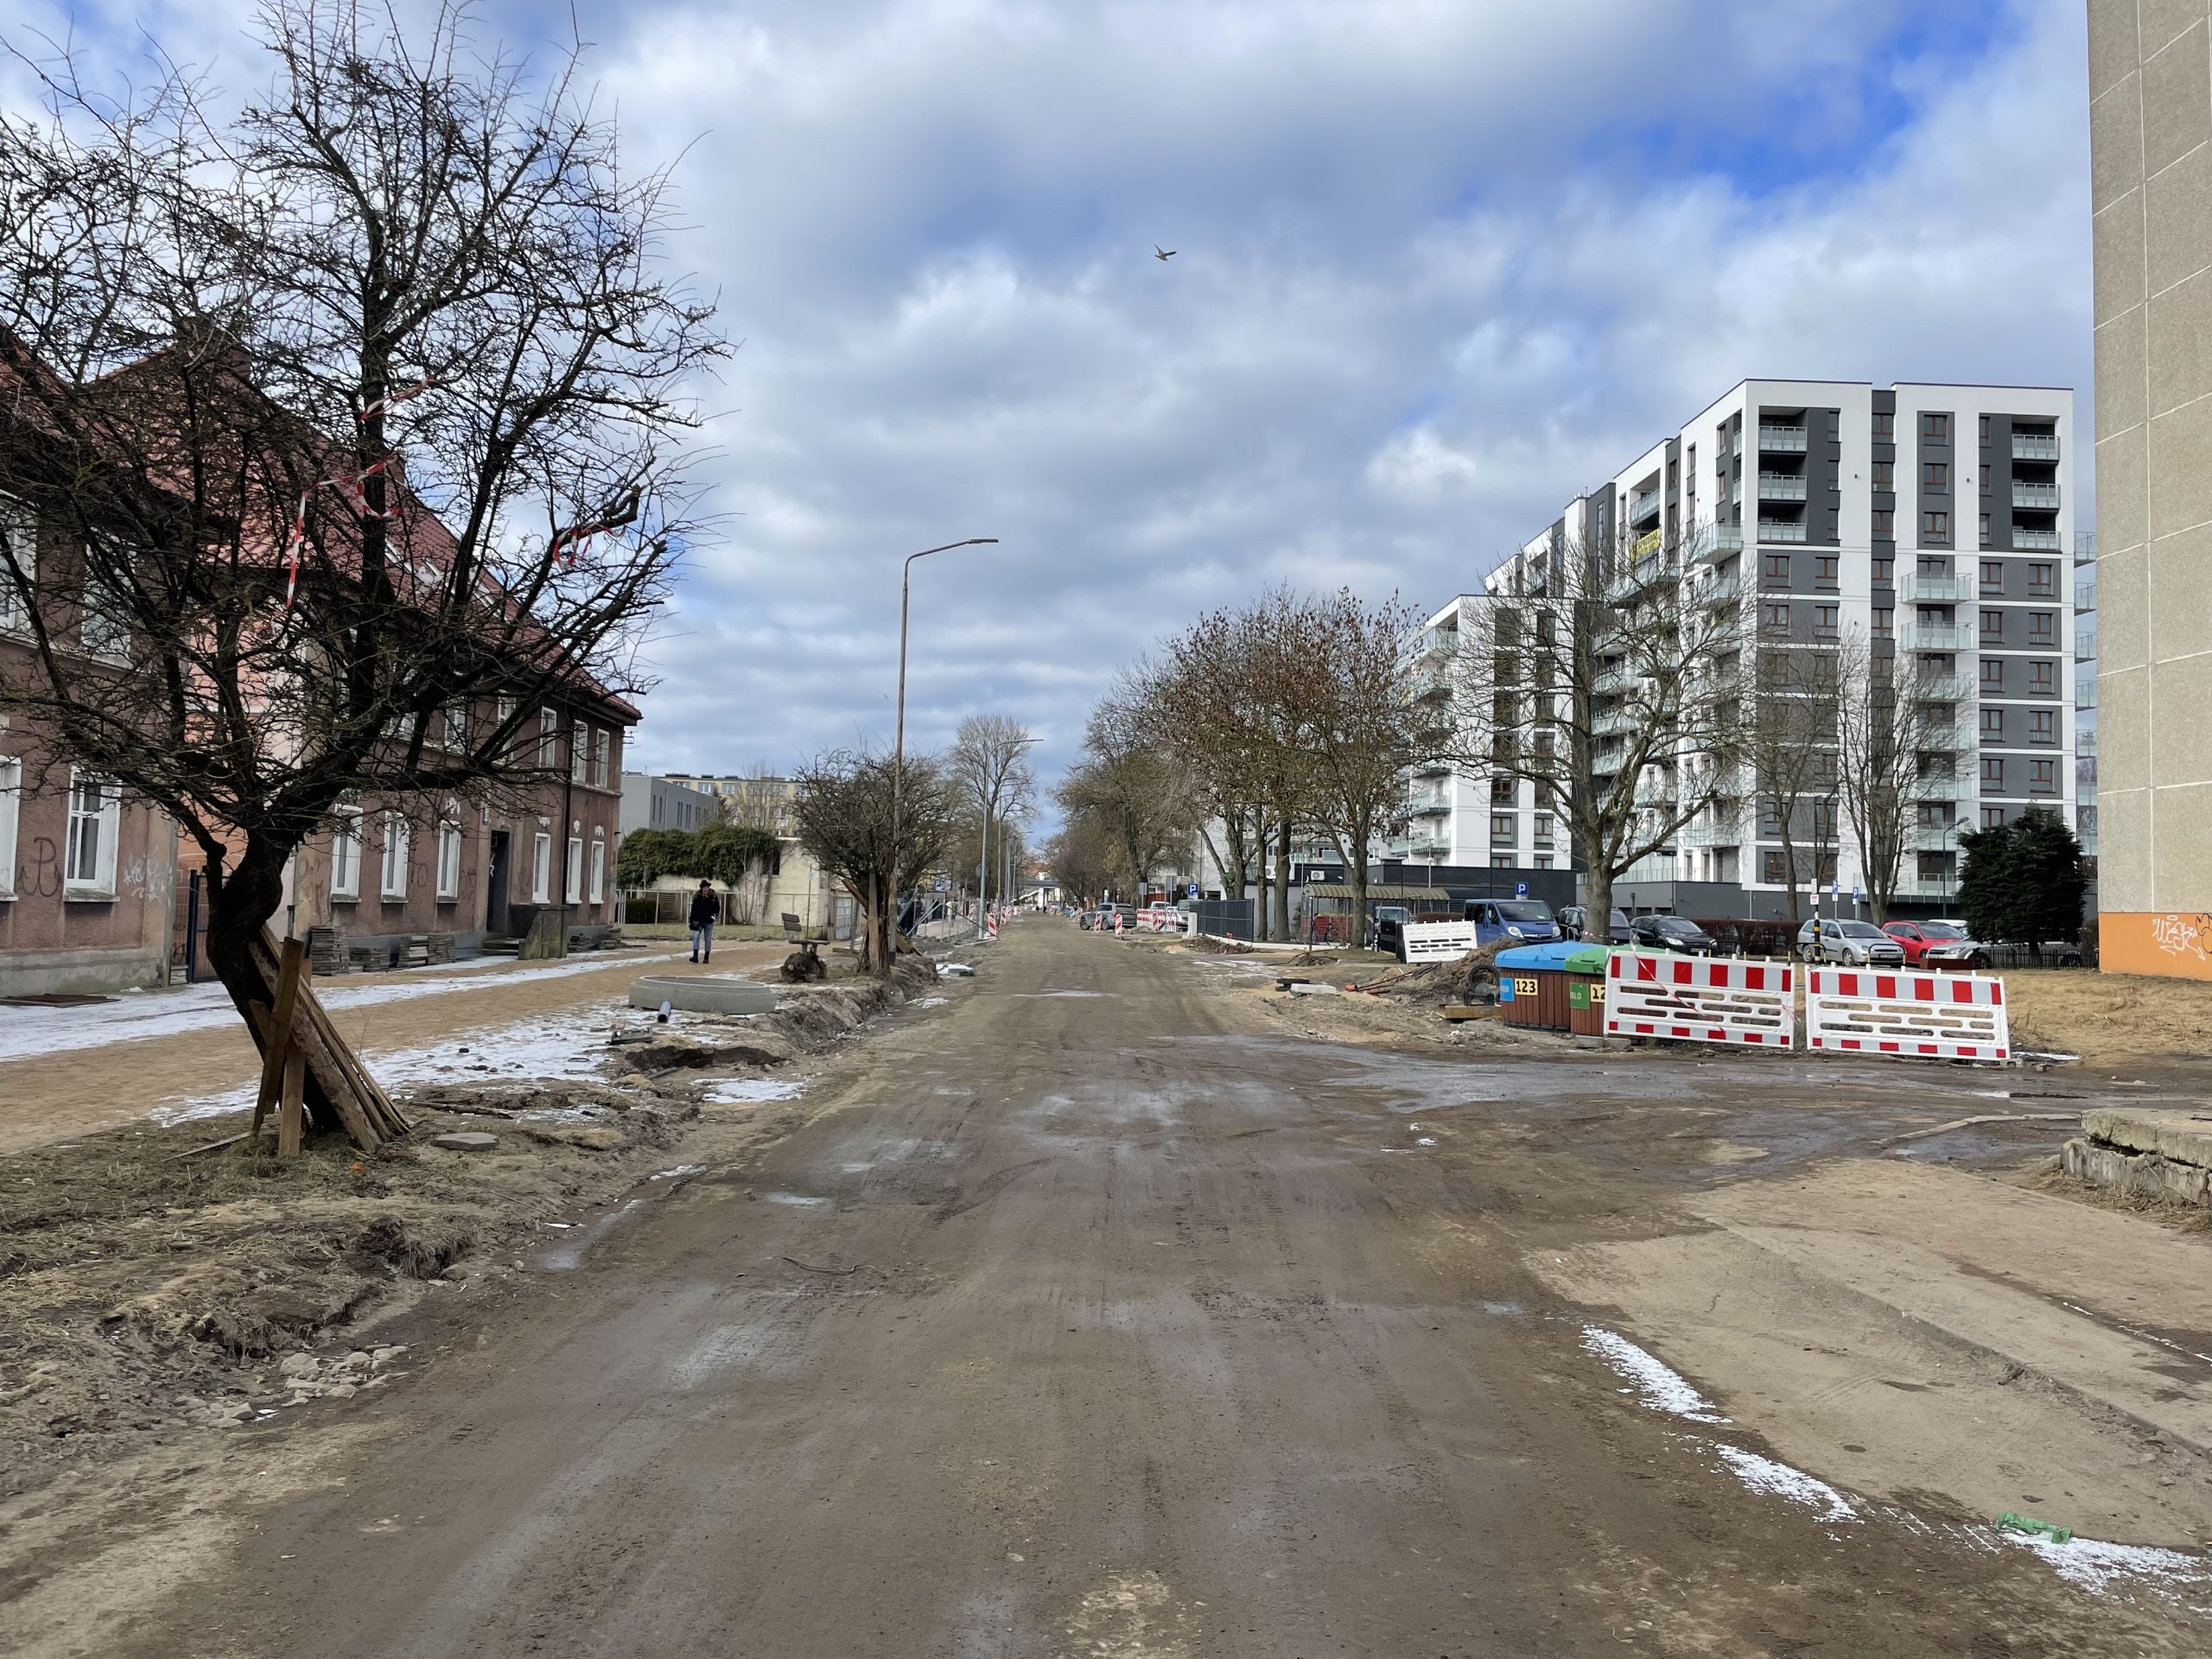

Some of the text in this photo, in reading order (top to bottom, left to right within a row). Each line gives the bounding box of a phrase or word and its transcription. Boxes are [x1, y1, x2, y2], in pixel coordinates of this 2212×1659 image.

[1189, 884, 1197, 893] P
[1518, 883, 1526, 893] P
[1516, 981, 1536, 994] 123
